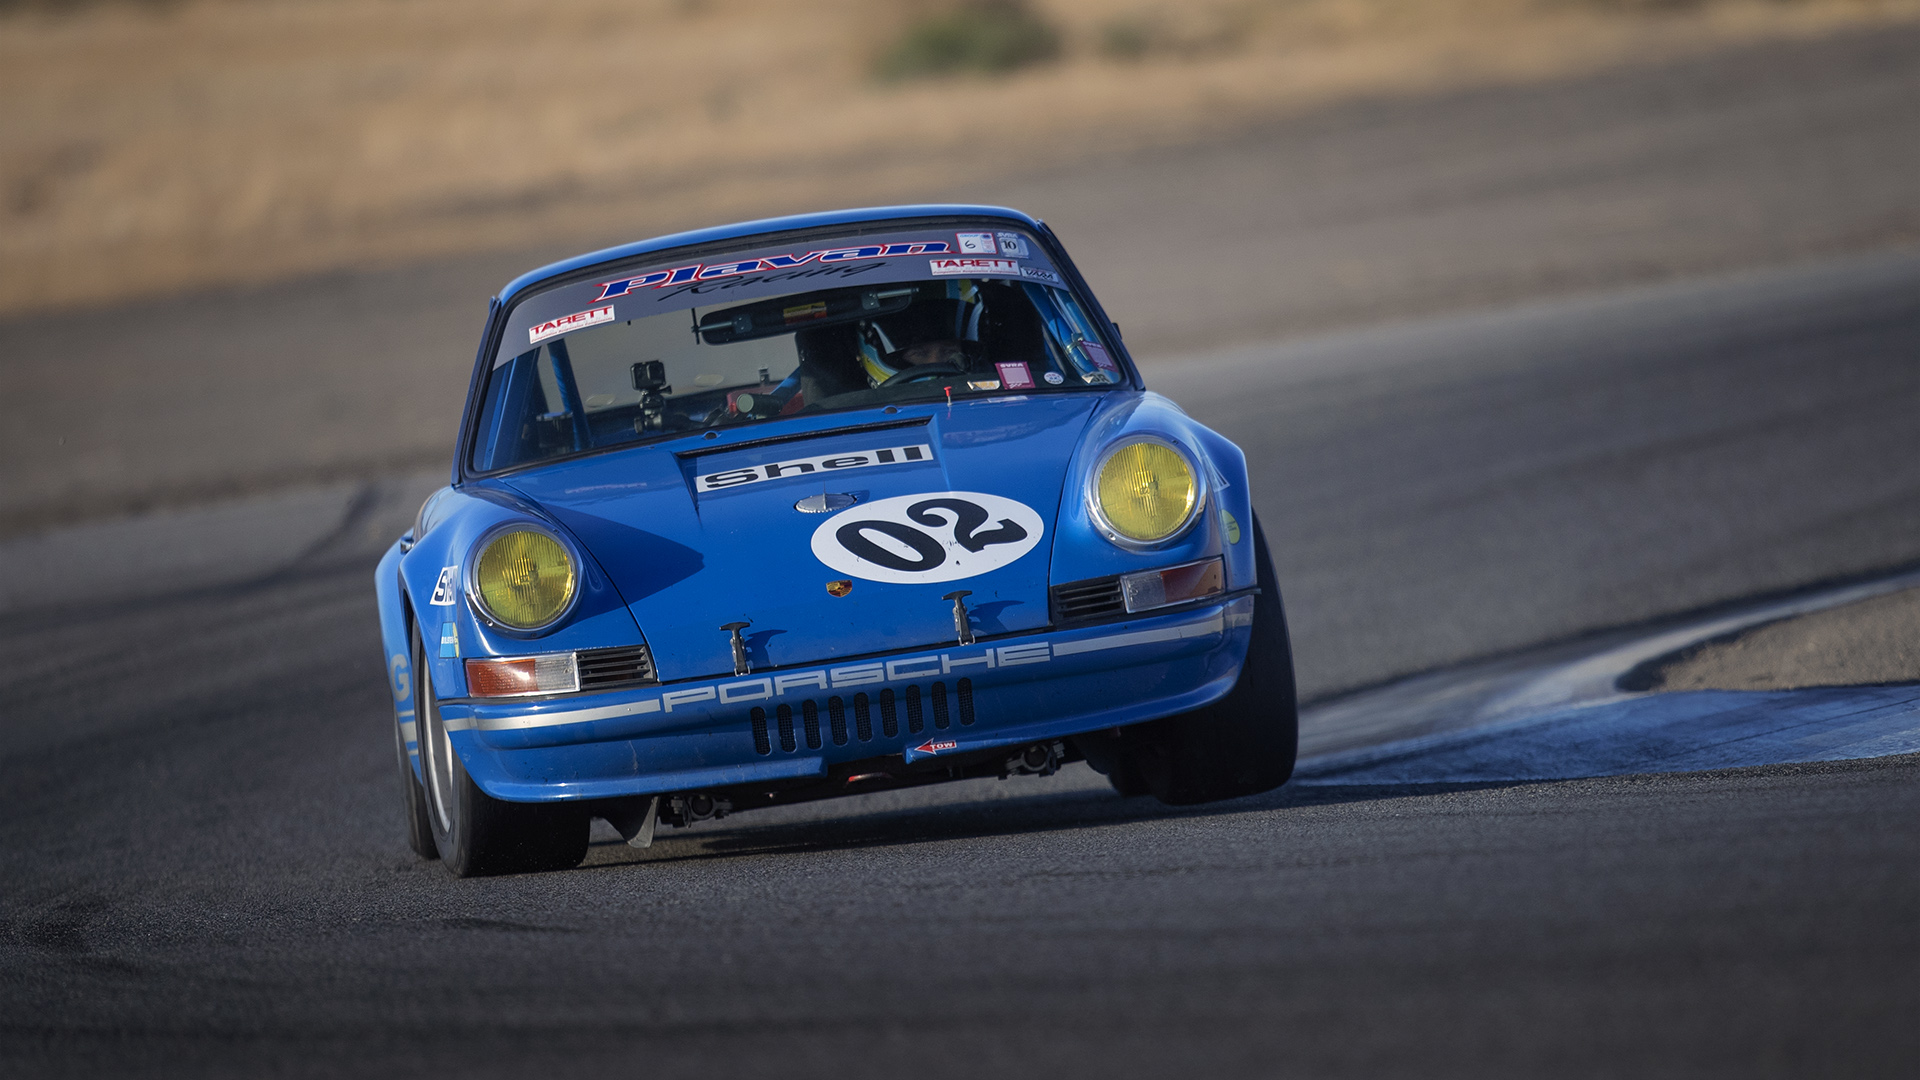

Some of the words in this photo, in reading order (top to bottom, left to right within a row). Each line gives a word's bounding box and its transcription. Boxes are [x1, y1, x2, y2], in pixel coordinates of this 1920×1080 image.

[964, 240, 976, 249] 6
[1003, 240, 1017, 250] 10
[588, 241, 958, 304] Plavan
[930, 259, 1017, 269] TARETT
[530, 305, 613, 335] TARETT
[704, 446, 924, 489] Shell
[835, 498, 1028, 572] 02
[662, 641, 1051, 713] PORSCHE
[930, 742, 953, 750] TOW
